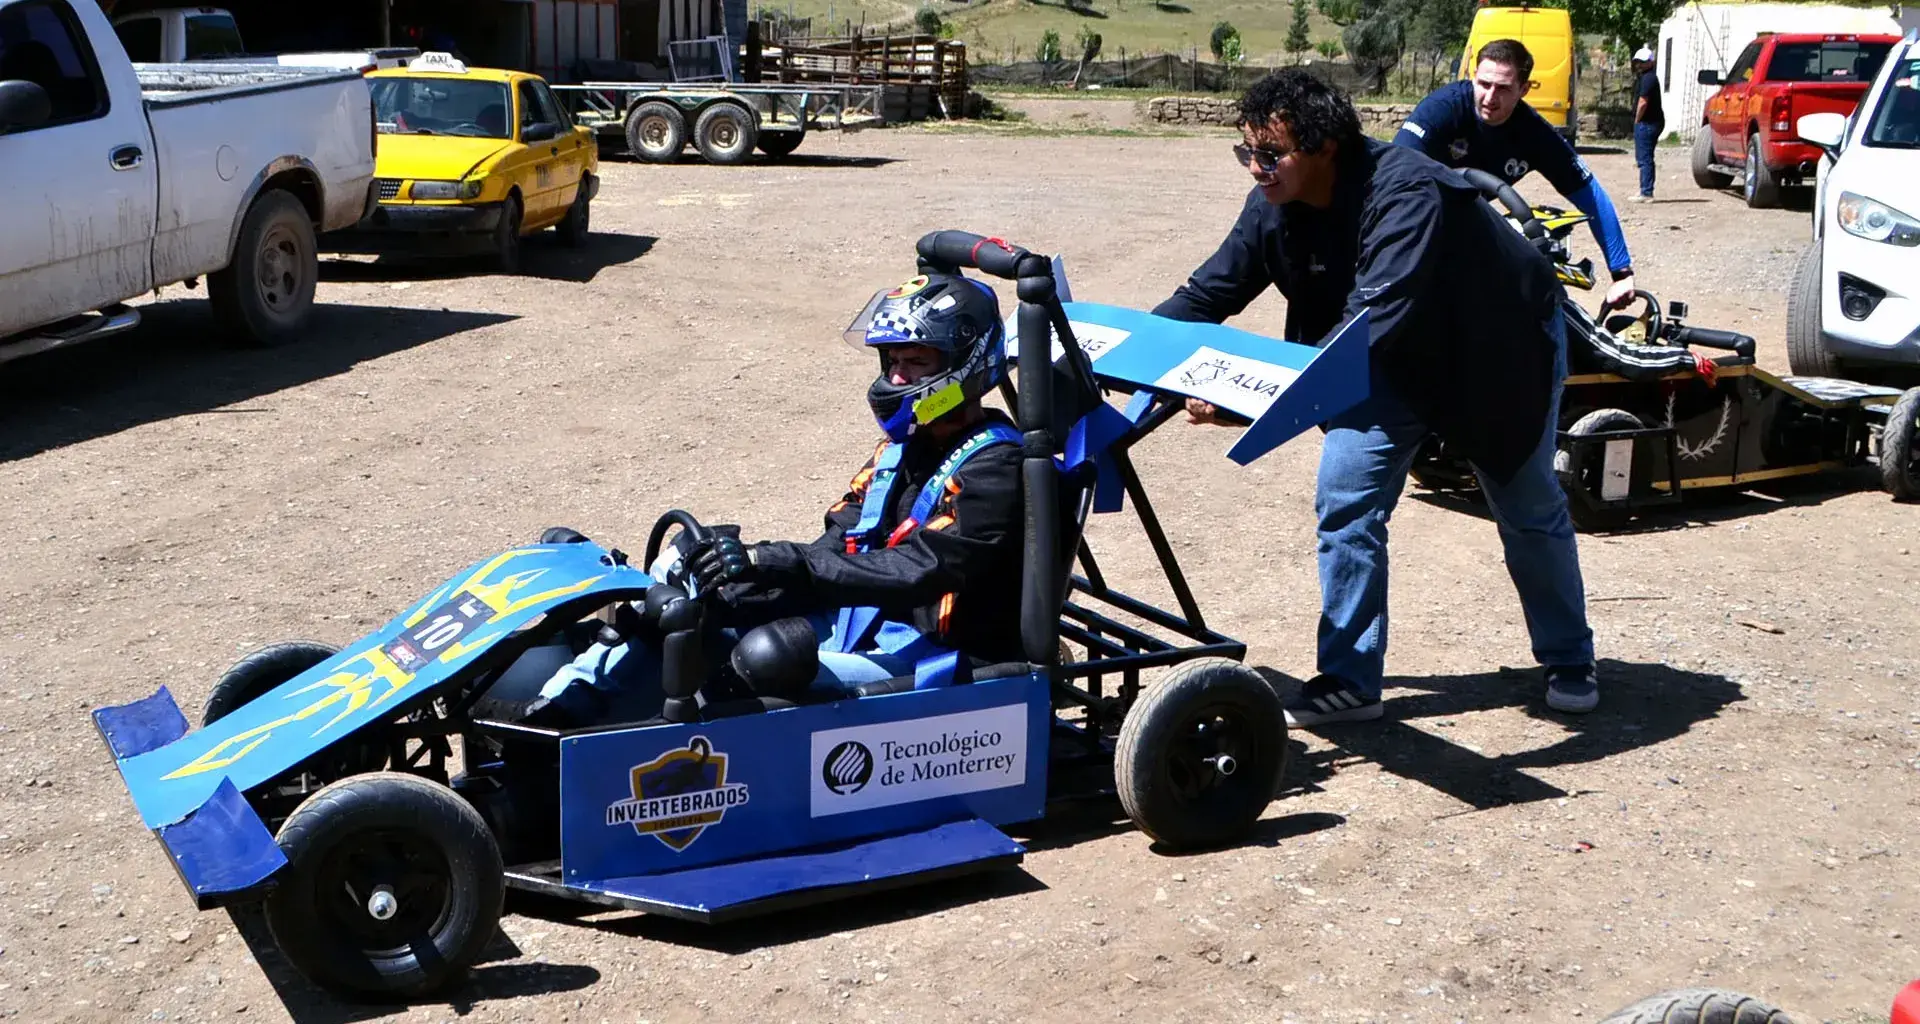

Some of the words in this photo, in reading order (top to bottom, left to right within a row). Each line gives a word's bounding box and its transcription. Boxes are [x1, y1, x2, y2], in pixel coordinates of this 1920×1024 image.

[425, 54, 448, 65] TAXI
[1225, 373, 1281, 397] ALVA
[932, 431, 988, 488] SPORT
[413, 614, 464, 650] 10
[881, 730, 1002, 762] Tecnológico
[881, 765, 905, 786] de
[912, 753, 1016, 783] Monterrey
[608, 786, 748, 824] INVERTEBRADOS
